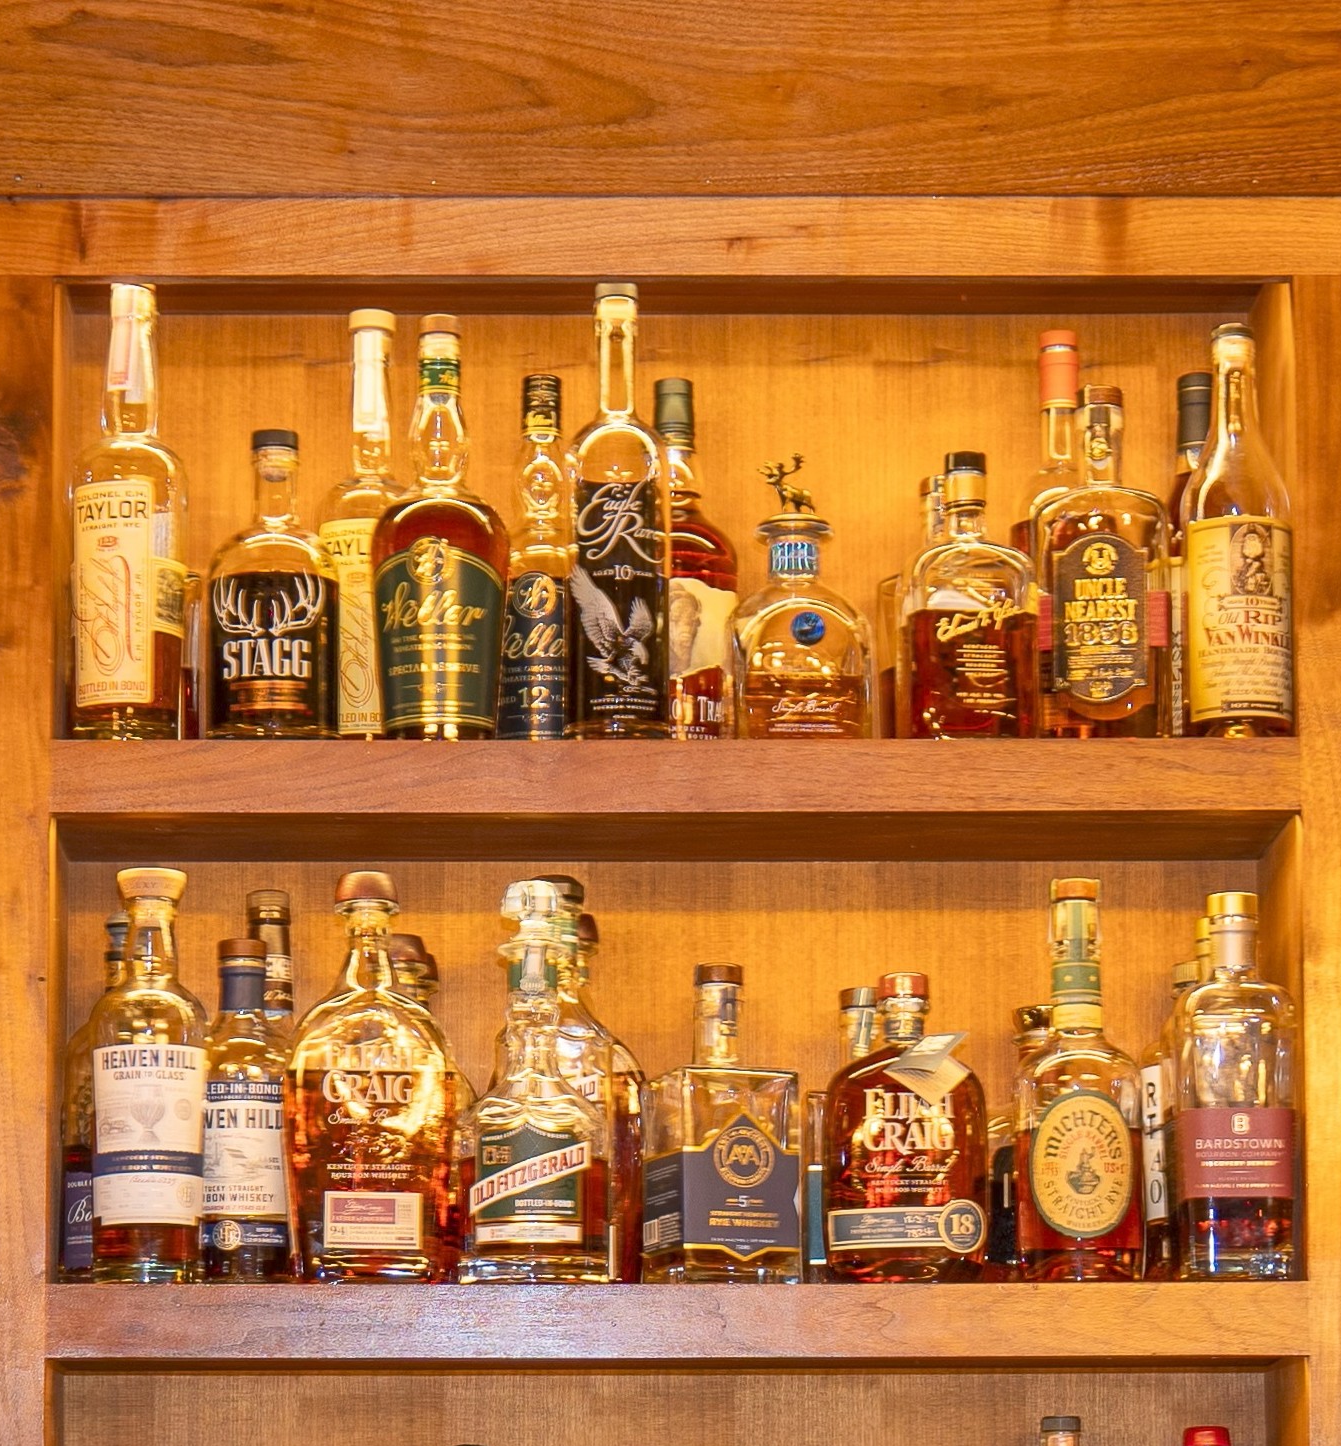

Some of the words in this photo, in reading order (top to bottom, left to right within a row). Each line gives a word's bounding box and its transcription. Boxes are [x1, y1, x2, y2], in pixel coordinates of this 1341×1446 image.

[77, 500, 148, 523] TAYLOR
[1074, 578, 1127, 599] UNCLE
[382, 581, 488, 633] Weller
[1064, 599, 1138, 622] NEAREST
[1243, 610, 1282, 626] RIP
[1064, 621, 1139, 646] 1856
[1205, 627, 1235, 647] VAN
[223, 638, 312, 679] STAGG
[518, 686, 549, 709] 12
[102, 1049, 159, 1071] HEAVEN
[165, 1049, 197, 1070] HILL
[113, 1069, 141, 1081] GRAIN
[154, 1069, 185, 1081] GLASS
[322, 1070, 413, 1104] CRAIG
[863, 1118, 956, 1154] CRAIG
[1044, 1110, 1122, 1159] MICHTER'S
[1195, 1139, 1282, 1149] BARDSTOWN
[473, 1182, 495, 1207] OLD
[495, 1146, 586, 1196] FITZGERALD
[864, 1156, 904, 1176] Single
[906, 1155, 952, 1174] Barrel
[229, 1192, 274, 1203] WHISKEY
[1042, 1180, 1106, 1221] STRAIGHT
[950, 1213, 975, 1236] 18
